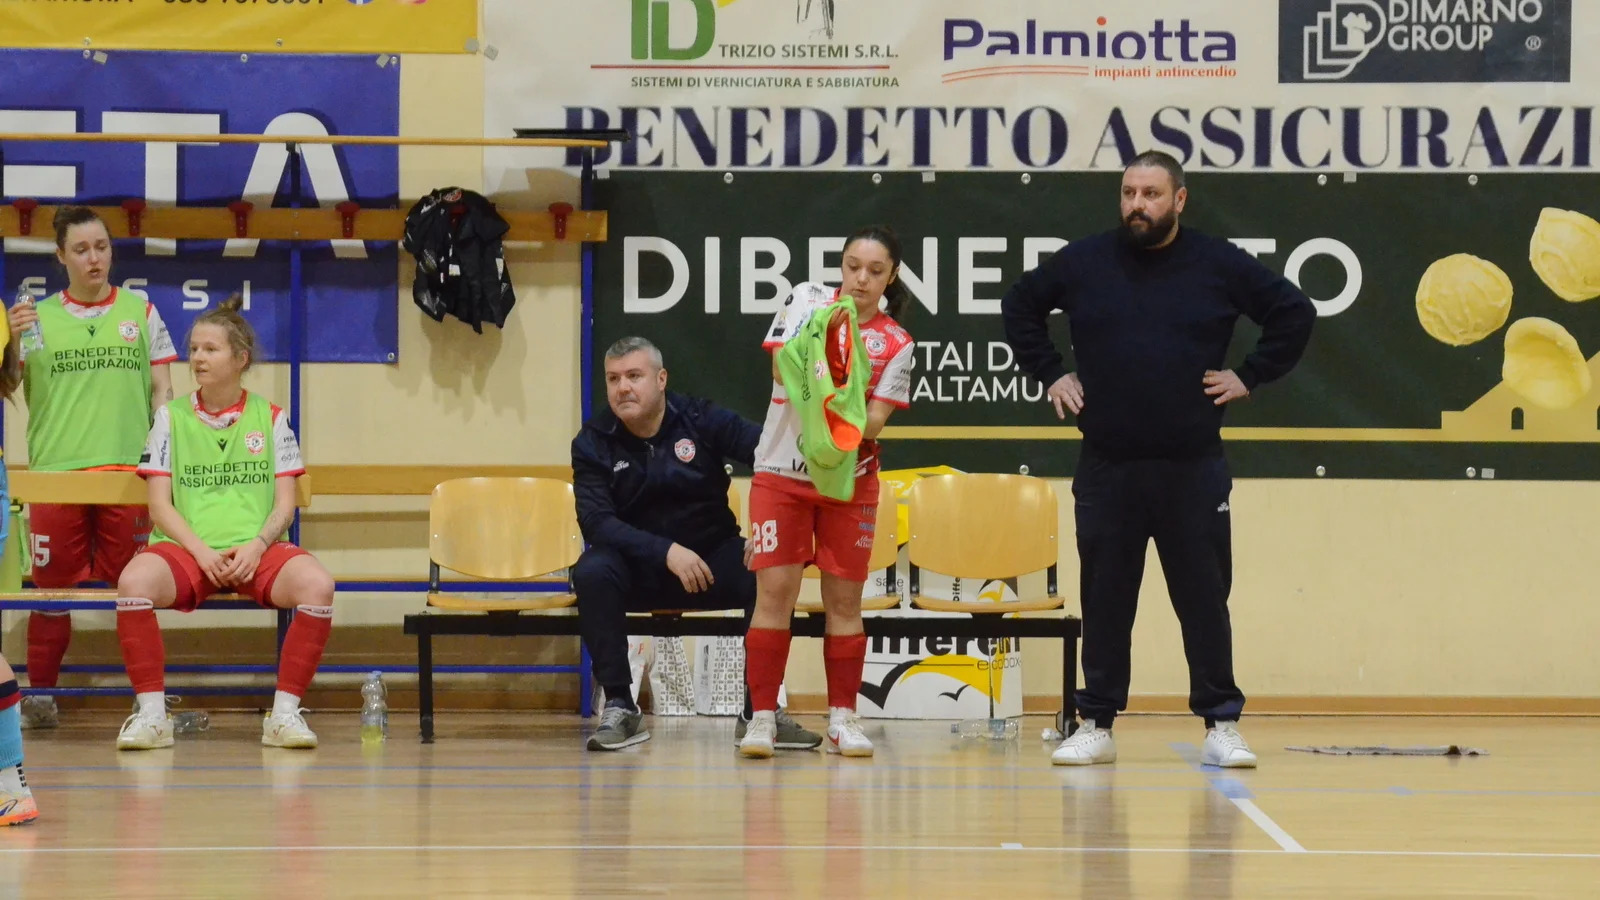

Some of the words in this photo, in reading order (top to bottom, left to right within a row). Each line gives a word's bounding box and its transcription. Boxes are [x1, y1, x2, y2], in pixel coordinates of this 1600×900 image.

[1389, 0, 1543, 23] DIMARNO
[944, 16, 1236, 62] Palmiotta
[1388, 24, 1493, 51] GROUP
[719, 44, 776, 58] TRIZIO
[781, 44, 849, 58] SISTEMI
[855, 44, 899, 58] S.R.L.
[631, 76, 683, 88] SISTEMI
[687, 76, 700, 88] DI
[704, 76, 802, 88] VERNICIATURA
[806, 76, 813, 88] E
[817, 76, 899, 88] SABBIATURA
[1095, 66, 1151, 80] impianti
[1156, 66, 1237, 78] antincendio
[562, 105, 1068, 168] BENEDETTO
[54, 346, 141, 361] BENEDETTO
[184, 460, 270, 476] BENEDETTO
[752, 519, 779, 554] 28
